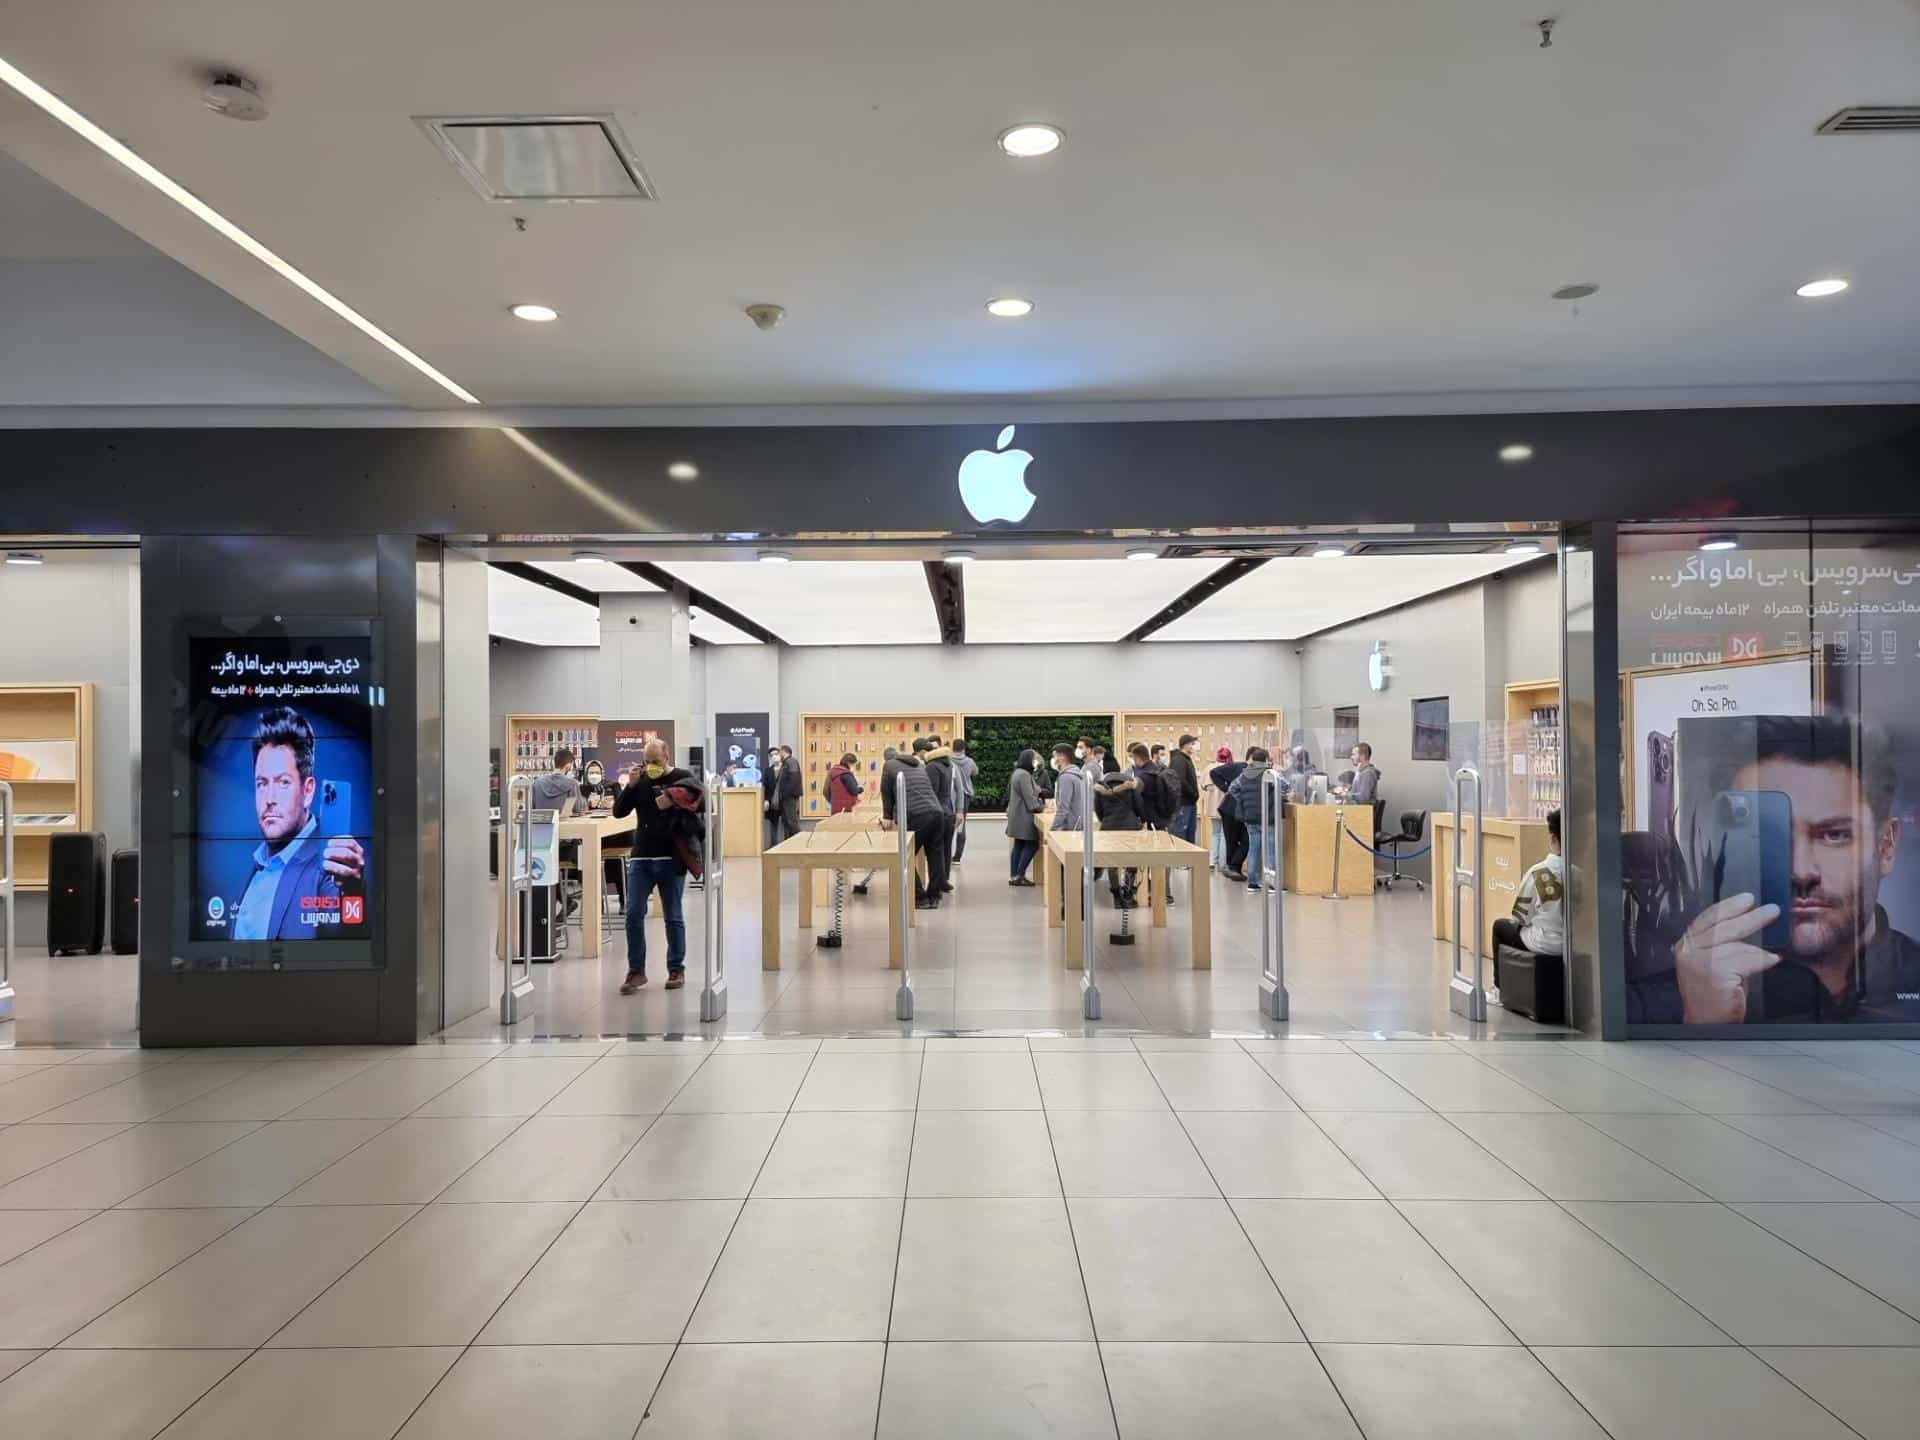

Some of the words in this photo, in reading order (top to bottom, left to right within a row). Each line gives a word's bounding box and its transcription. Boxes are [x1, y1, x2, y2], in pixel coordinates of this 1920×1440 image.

[1709, 567, 1722, 587] و
[1726, 558, 1753, 580] اما
[1756, 566, 1788, 588] بی
[1650, 603, 1682, 620] ایران
[1684, 605, 1714, 620] بیمه
[1763, 601, 1804, 618] همراه
[1806, 601, 1840, 618] تلفن
[1840, 603, 1880, 618] معتبر
[1881, 600, 1920, 614] مانت
[236, 660, 244, 675] و
[245, 654, 259, 670] اما
[260, 661, 276, 675] بی
